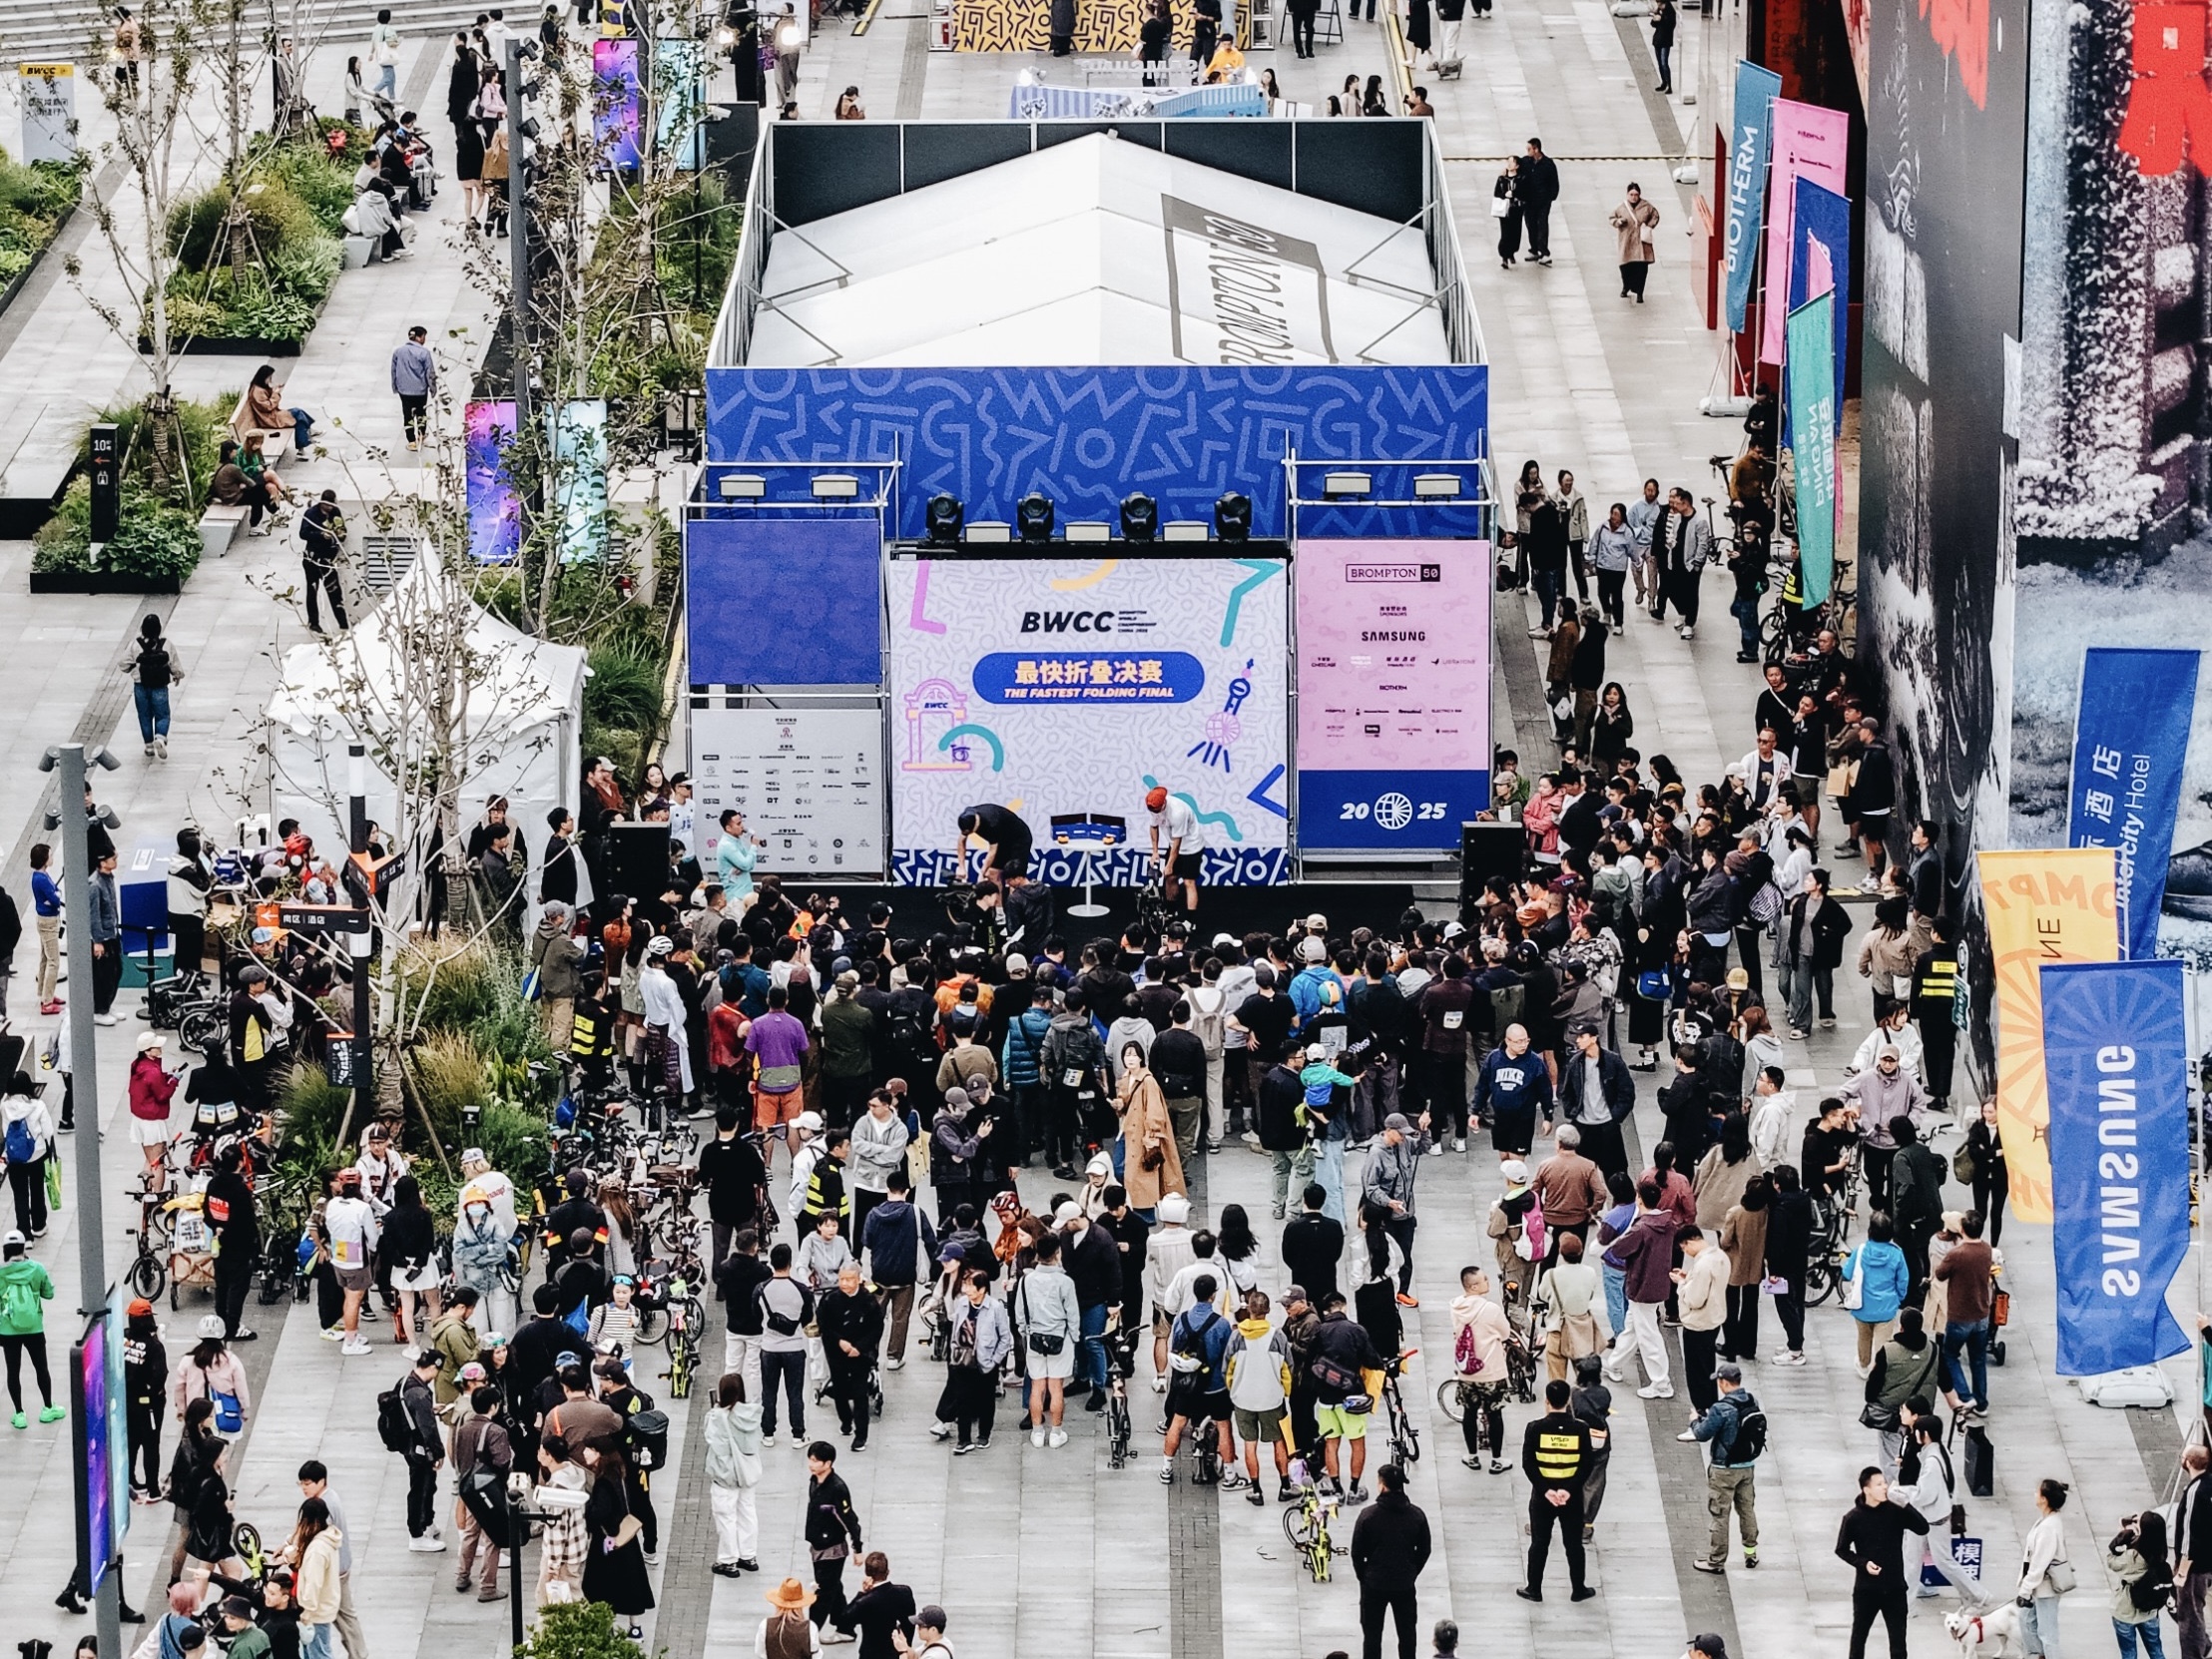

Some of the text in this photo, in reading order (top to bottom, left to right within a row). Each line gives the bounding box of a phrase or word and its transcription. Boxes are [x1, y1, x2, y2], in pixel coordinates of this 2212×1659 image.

[1728, 126, 1758, 273] BIOTHERM
[1351, 568, 1438, 578] BROMPTON 50
[1020, 611, 1115, 633] BWCC
[1361, 631, 1426, 642] SAMSUNG
[1014, 659, 1163, 685] 最快折叠决赛
[1004, 688, 1175, 699] THE FASTEST FOLDING FINAL
[2123, 754, 2151, 810] Hotel
[1340, 802, 1447, 820] 20 25
[1495, 1067, 1525, 1086] NIKE
